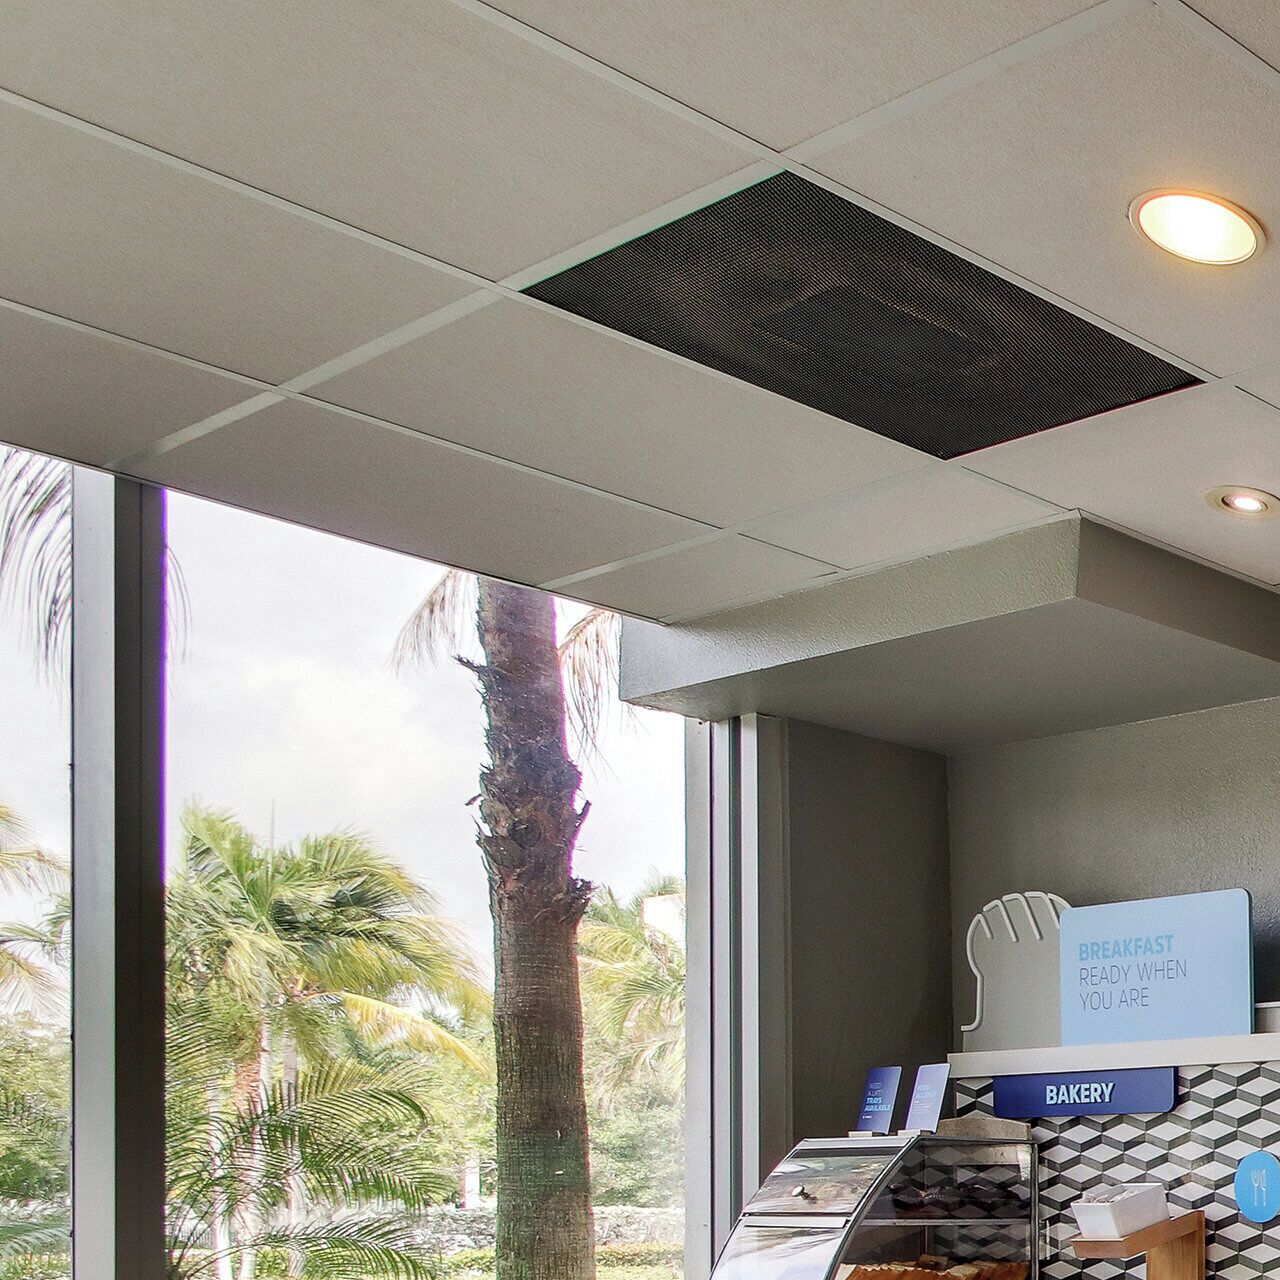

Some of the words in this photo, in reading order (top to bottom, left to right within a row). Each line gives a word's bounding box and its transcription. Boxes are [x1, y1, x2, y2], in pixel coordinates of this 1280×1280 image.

[1078, 934, 1175, 962] BREAKFAST
[1079, 964, 1132, 987] READY
[1137, 959, 1188, 981] WHEN
[1080, 990, 1113, 1012] YOU
[1118, 987, 1150, 1009] ARE
[1045, 1082, 1115, 1106] BAKERY
